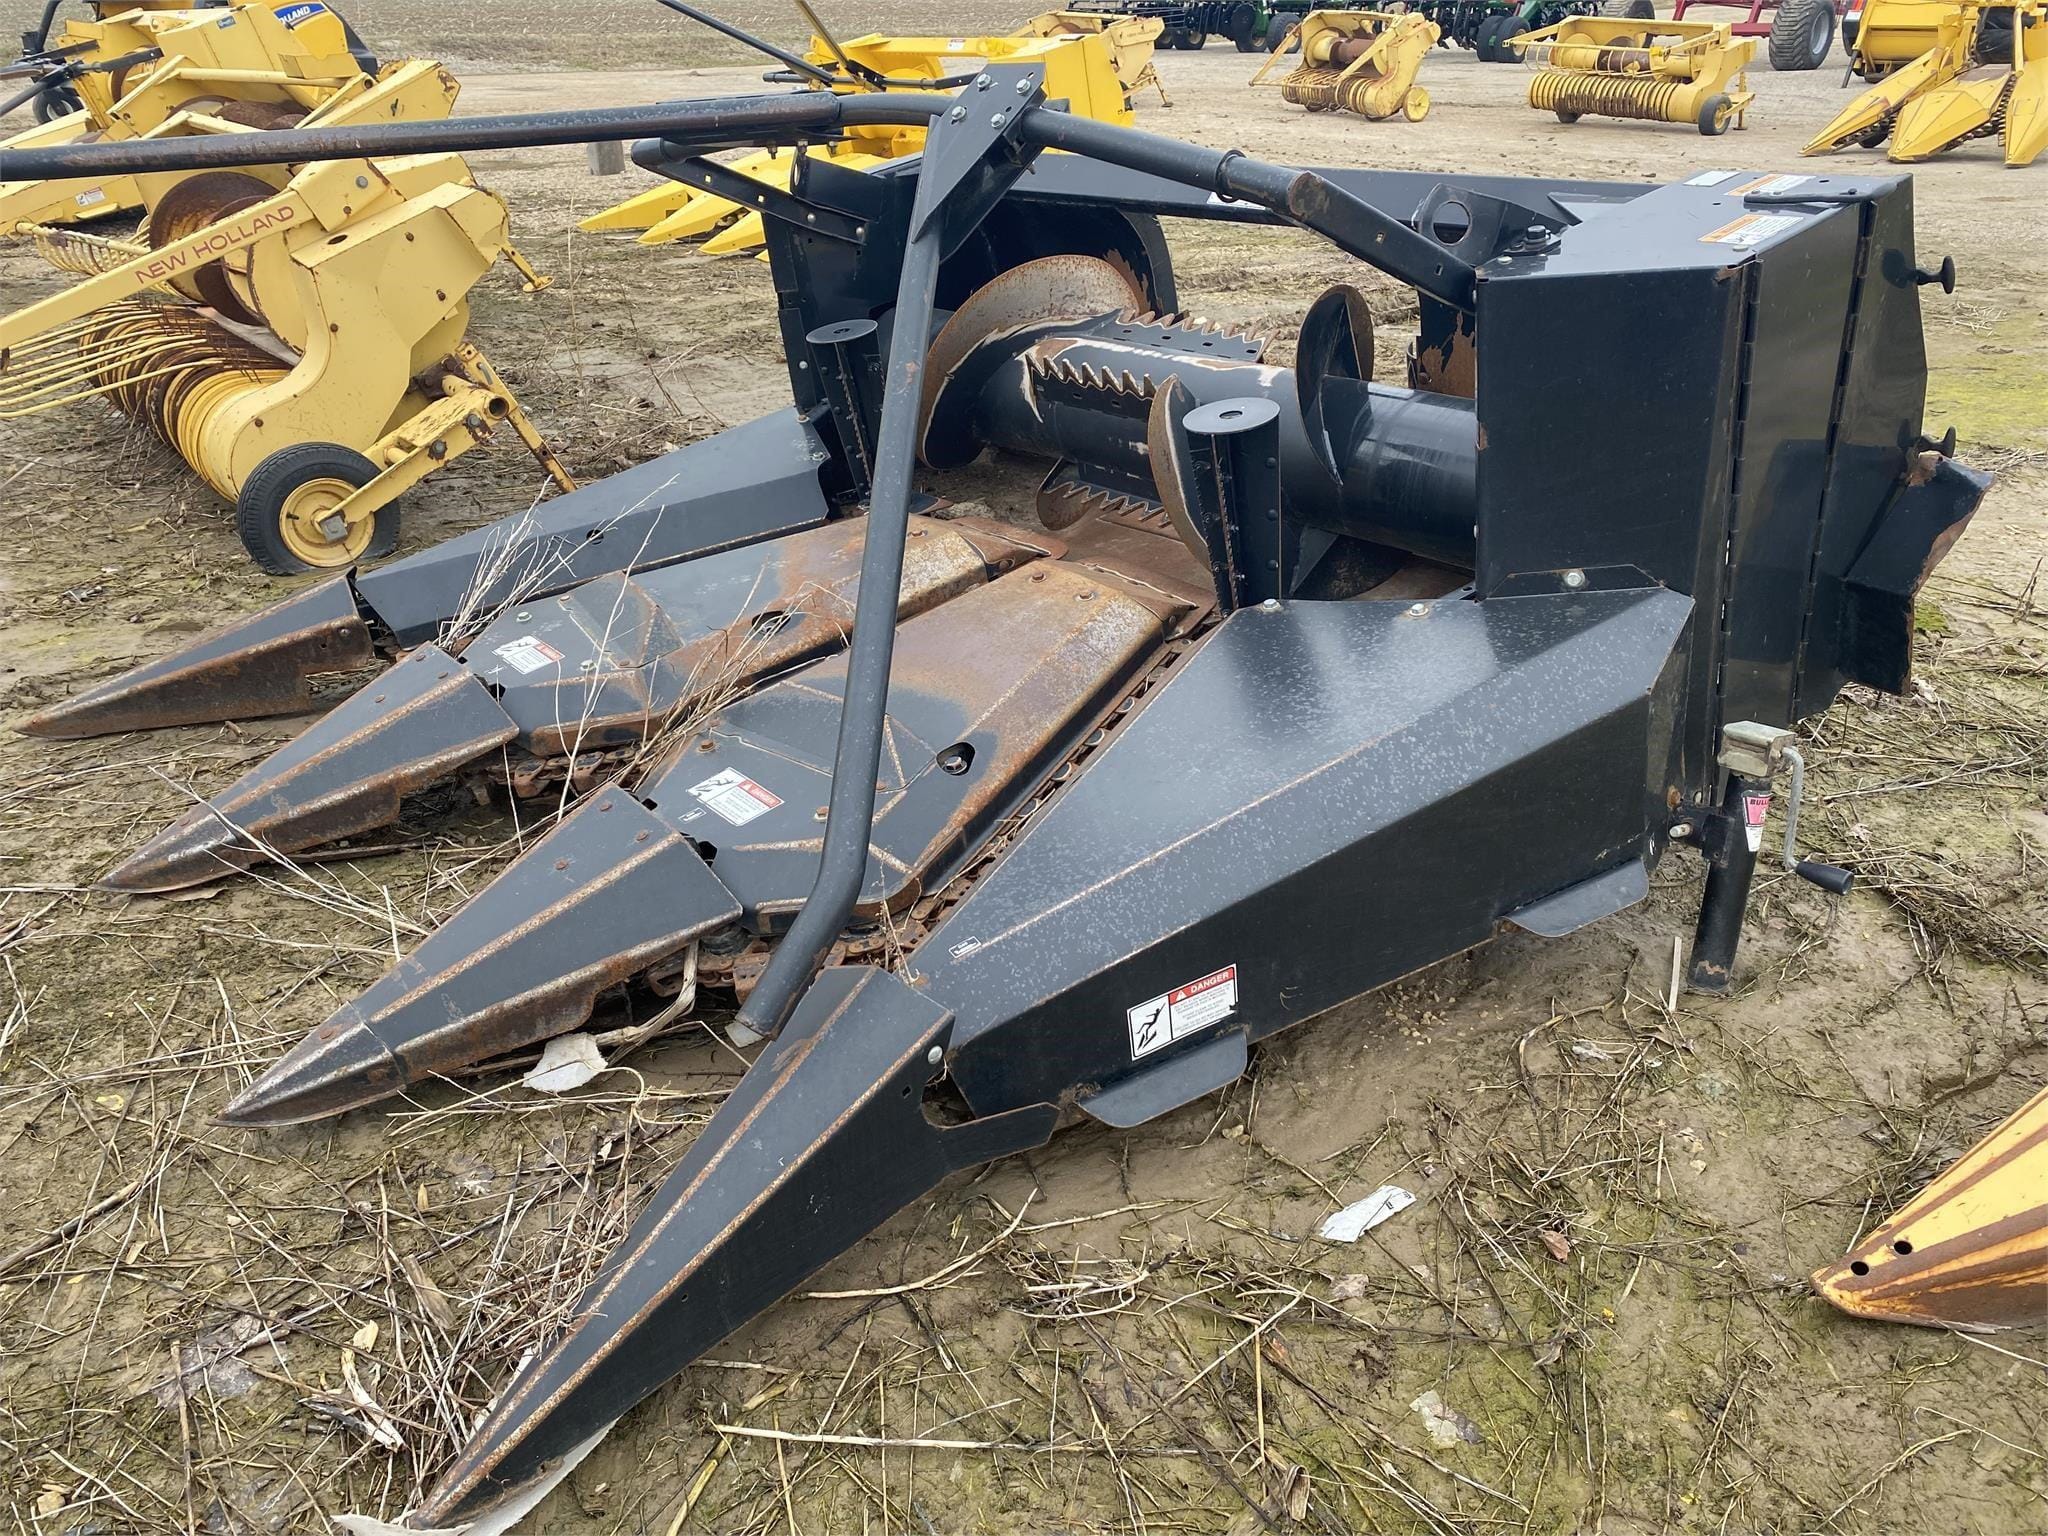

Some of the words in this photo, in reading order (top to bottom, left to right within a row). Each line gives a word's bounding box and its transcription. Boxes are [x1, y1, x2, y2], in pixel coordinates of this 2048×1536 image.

[136, 252, 187, 284] NEW
[192, 207, 295, 259] HOLLAND
[1191, 972, 1229, 993] DANGER
